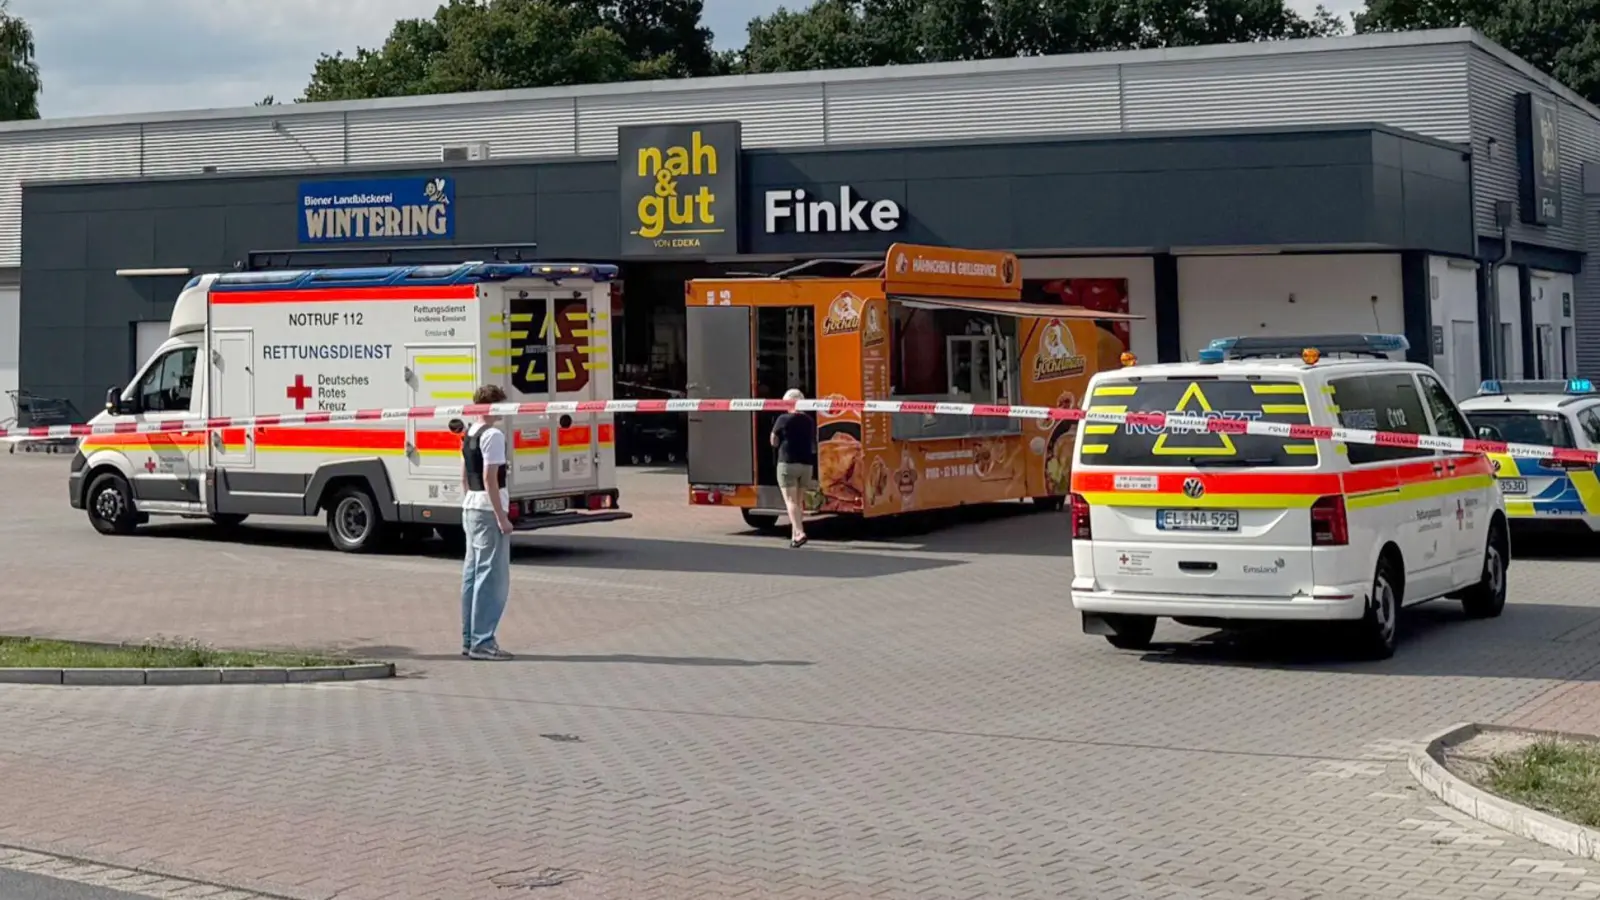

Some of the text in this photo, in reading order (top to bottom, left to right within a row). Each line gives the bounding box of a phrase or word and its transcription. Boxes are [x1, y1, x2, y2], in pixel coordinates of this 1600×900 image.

[638, 131, 717, 176] nah
[655, 169, 677, 196] &
[304, 192, 393, 206] Biener Landbäckerei
[638, 186, 715, 237] gut
[765, 185, 900, 233] Finke
[305, 203, 447, 239] WINTERING
[653, 239, 700, 248] VON EDEKA
[414, 305, 466, 315] Rettungsdienst
[289, 313, 364, 326] NOTRUF 112
[263, 344, 393, 360] RETTUNGSDIENST
[318, 373, 369, 386] Deutsches
[318, 387, 346, 399] Rotes
[318, 400, 347, 411] Kreuz
[1124, 410, 1263, 435] NOTARZT
[1501, 480, 1525, 491] 3530
[1165, 510, 1237, 526] EL NA 525
